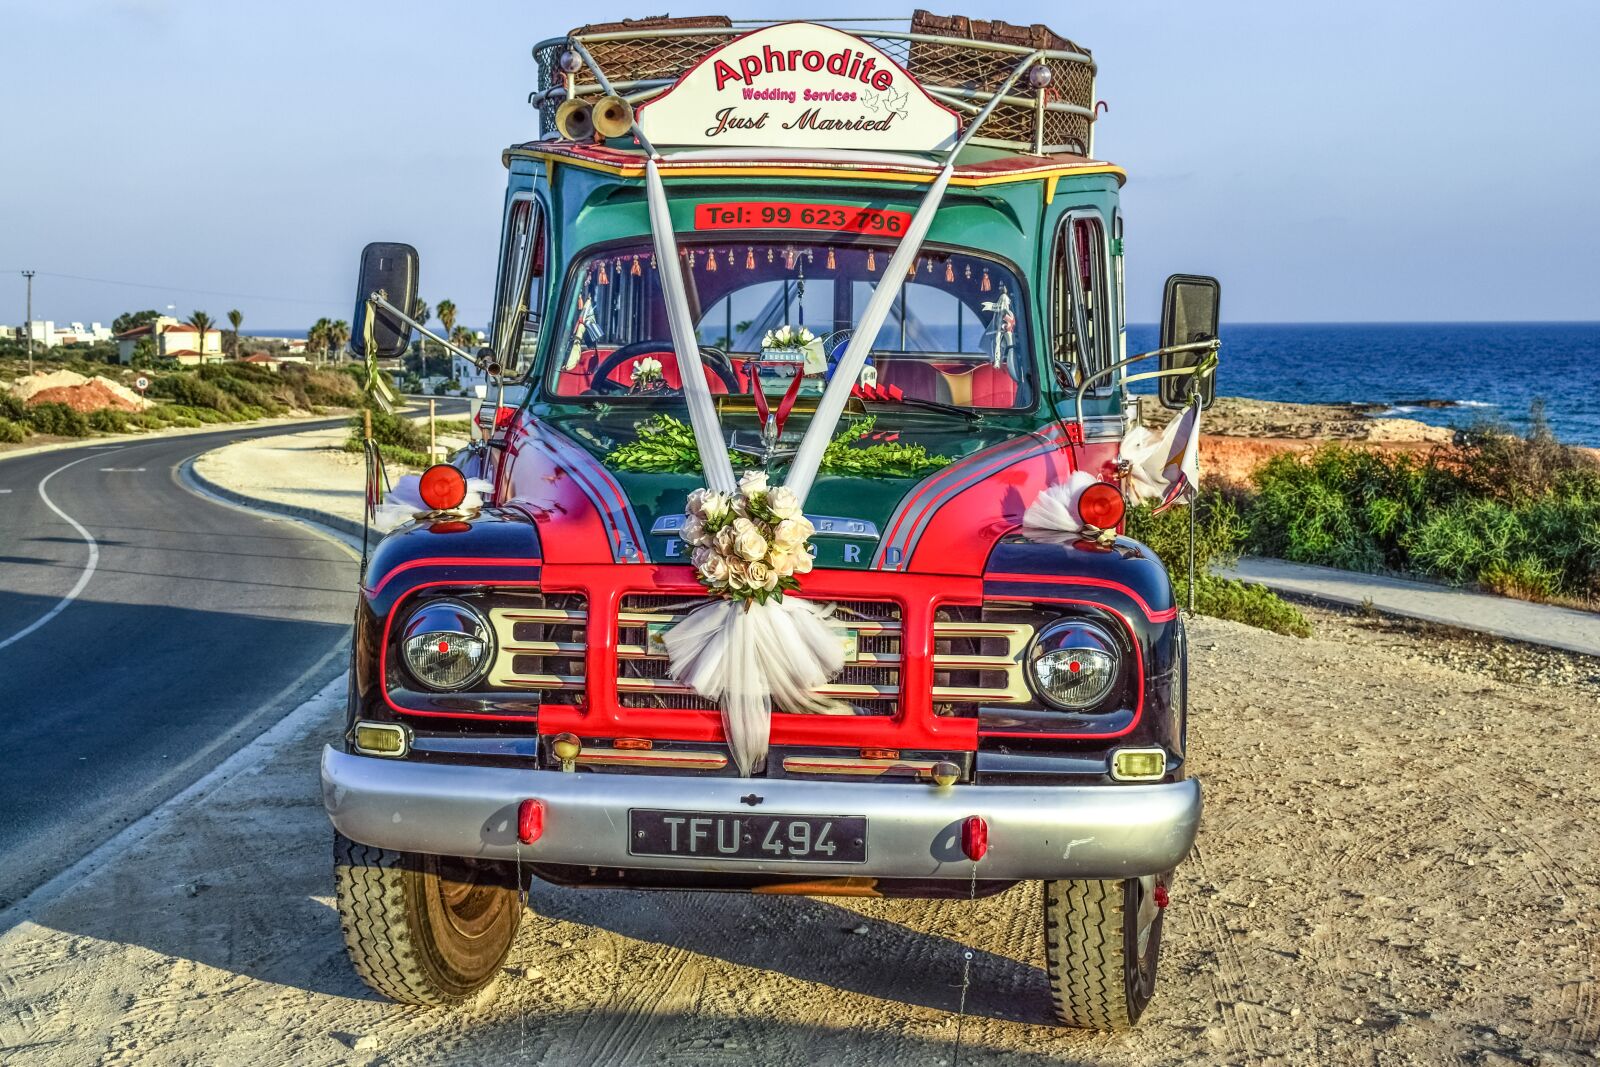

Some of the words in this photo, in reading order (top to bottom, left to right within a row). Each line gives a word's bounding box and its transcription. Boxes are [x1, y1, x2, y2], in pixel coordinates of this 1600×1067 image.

[714, 45, 893, 91] Aphrodite
[742, 88, 796, 104] Wedding
[803, 88, 857, 102] Services
[705, 107, 769, 137] Just
[782, 108, 897, 131] Married
[706, 207, 751, 224] Tel:
[761, 207, 792, 224] 99
[801, 208, 846, 226] 623
[857, 212, 901, 232] 796
[663, 817, 740, 854] TFU
[761, 820, 836, 856] 494
